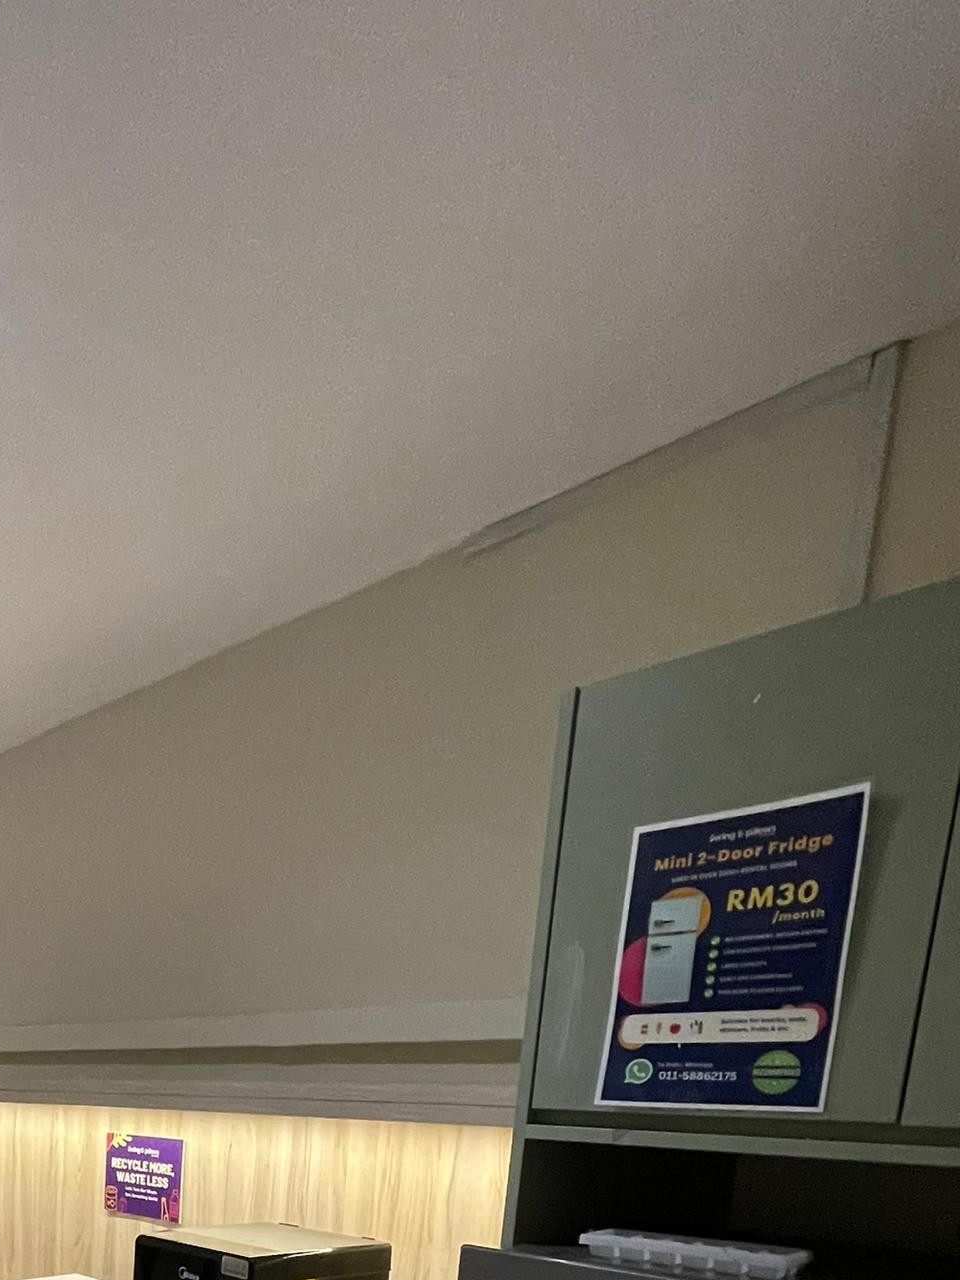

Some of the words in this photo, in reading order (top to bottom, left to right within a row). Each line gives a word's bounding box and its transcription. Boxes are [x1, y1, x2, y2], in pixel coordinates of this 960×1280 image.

[654, 852, 693, 872] Mini
[697, 845, 764, 864] 2-Door
[767, 834, 834, 854] Fridge
[726, 879, 820, 912] RM30
[771, 908, 826, 925] /month
[111, 1157, 148, 1173] RECYCLE
[149, 1163, 174, 1177] MORE,
[116, 1171, 146, 1186] WASTE
[147, 1175, 169, 1189] LESS
